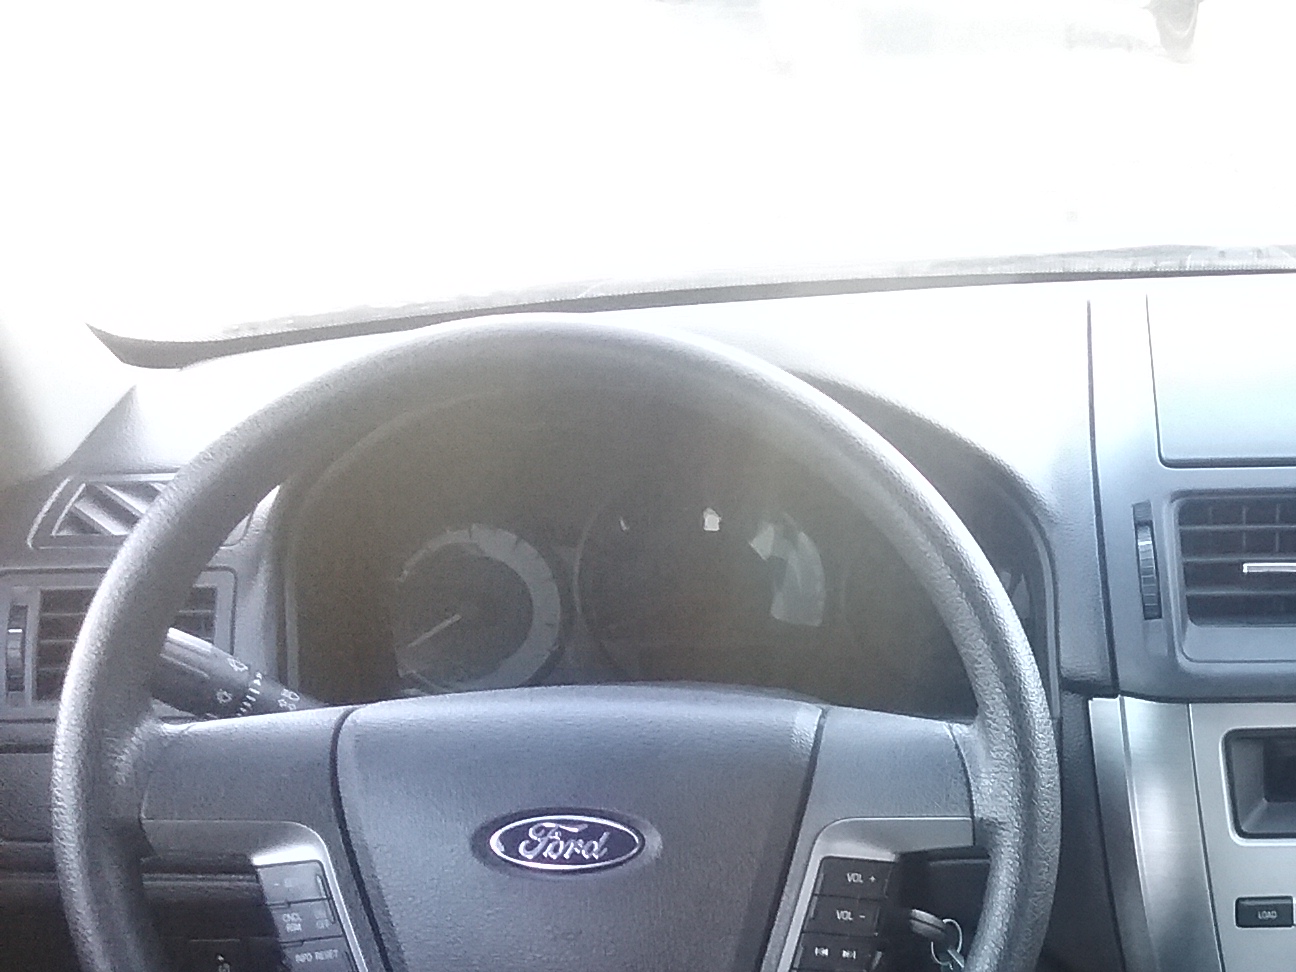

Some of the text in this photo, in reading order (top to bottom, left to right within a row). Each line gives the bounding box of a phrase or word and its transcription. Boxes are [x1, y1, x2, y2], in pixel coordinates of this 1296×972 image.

[518, 822, 611, 860] Ford
[846, 872, 864, 884] VOL
[836, 909, 853, 921] VOL
[1257, 910, 1278, 920] LOAD
